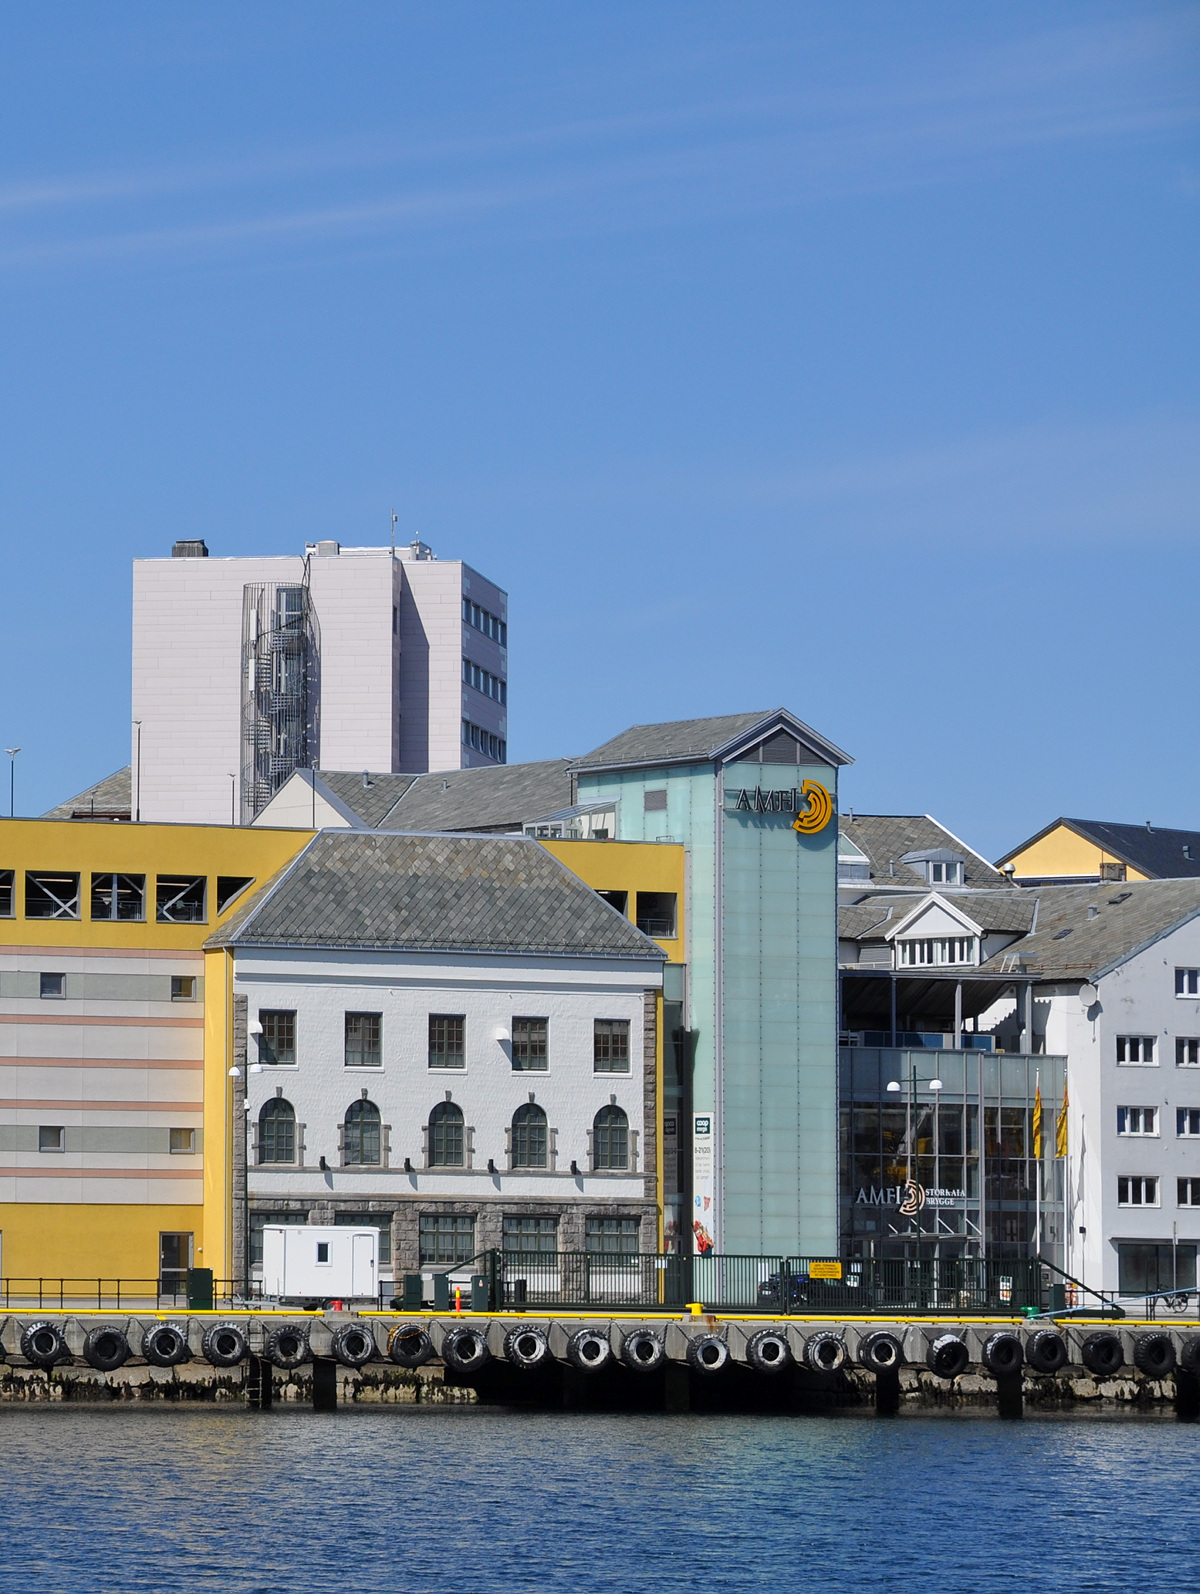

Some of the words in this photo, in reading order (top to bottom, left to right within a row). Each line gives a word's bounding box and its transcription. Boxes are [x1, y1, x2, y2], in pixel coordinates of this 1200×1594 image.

[856, 1185, 901, 1206] AMFI
[925, 1188, 966, 1197] STORKAIA
[925, 1197, 955, 1206] BRYGGE
